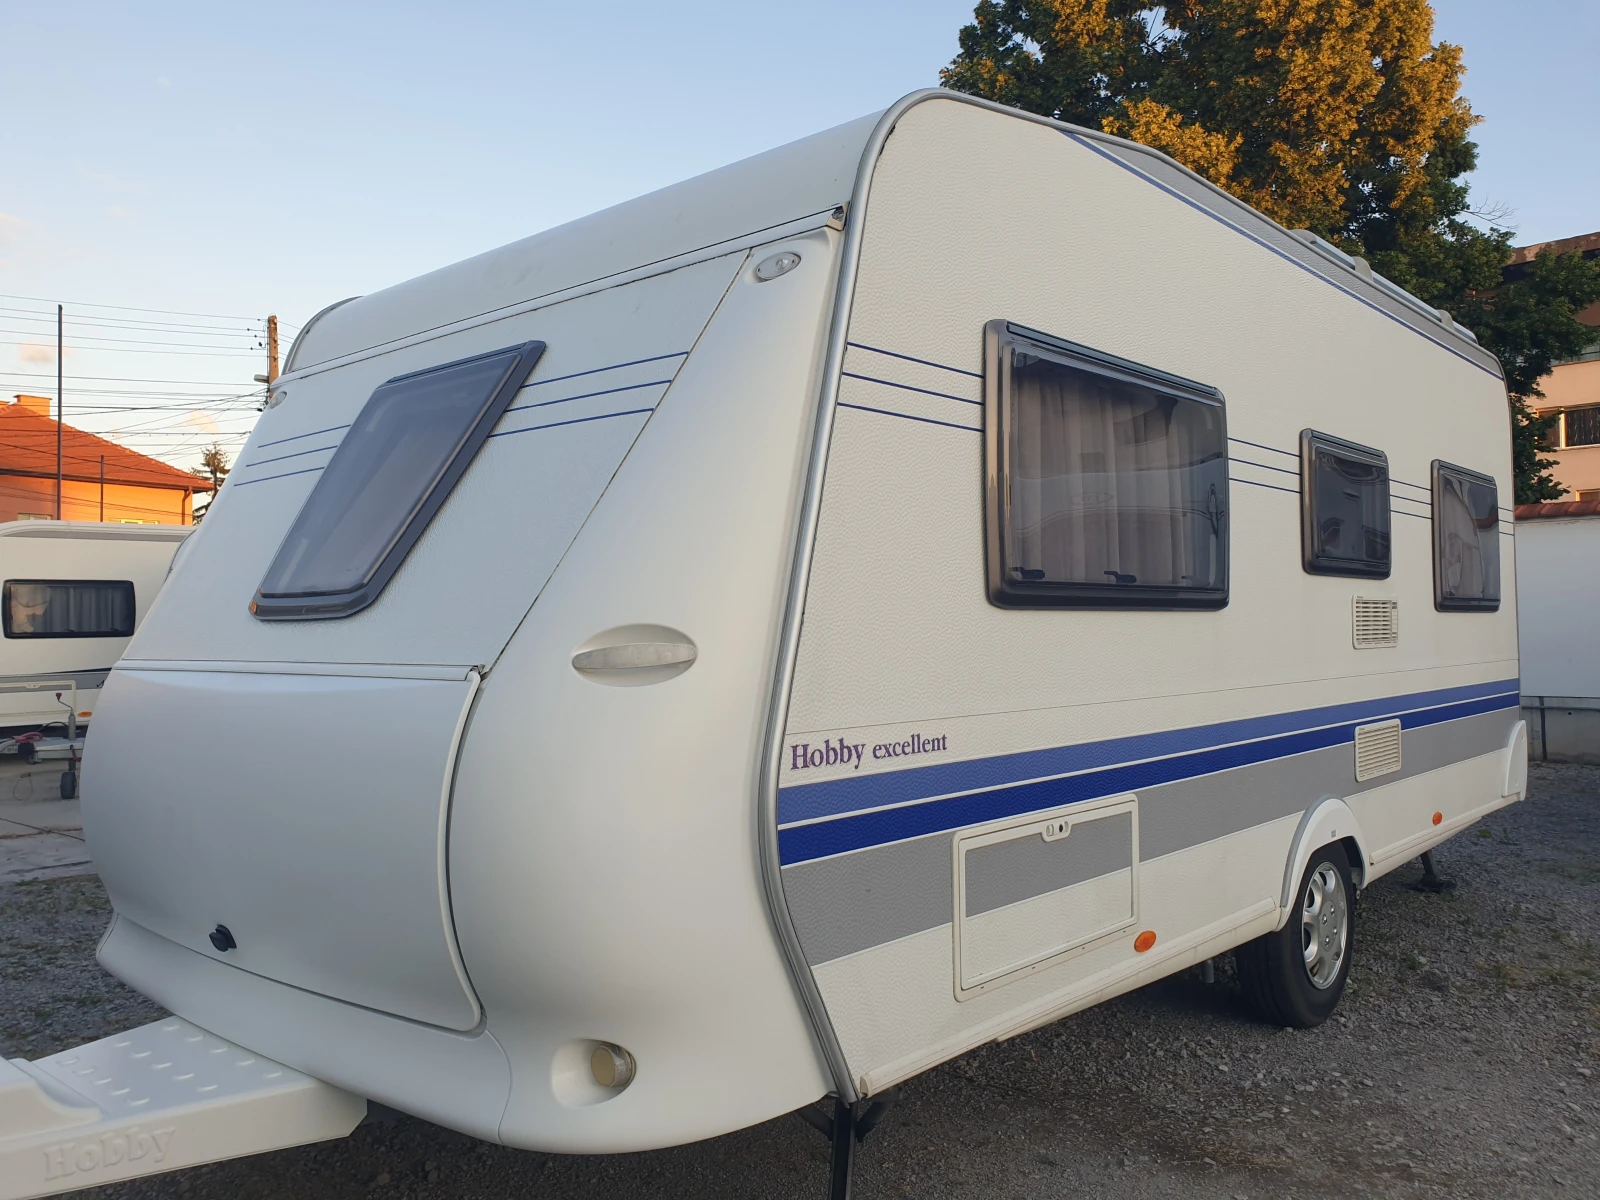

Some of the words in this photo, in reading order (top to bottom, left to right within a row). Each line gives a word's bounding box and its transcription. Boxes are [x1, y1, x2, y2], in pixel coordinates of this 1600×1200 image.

[790, 737, 866, 770] Hobby
[872, 733, 948, 759] excellent
[43, 1127, 176, 1181] Hobby
